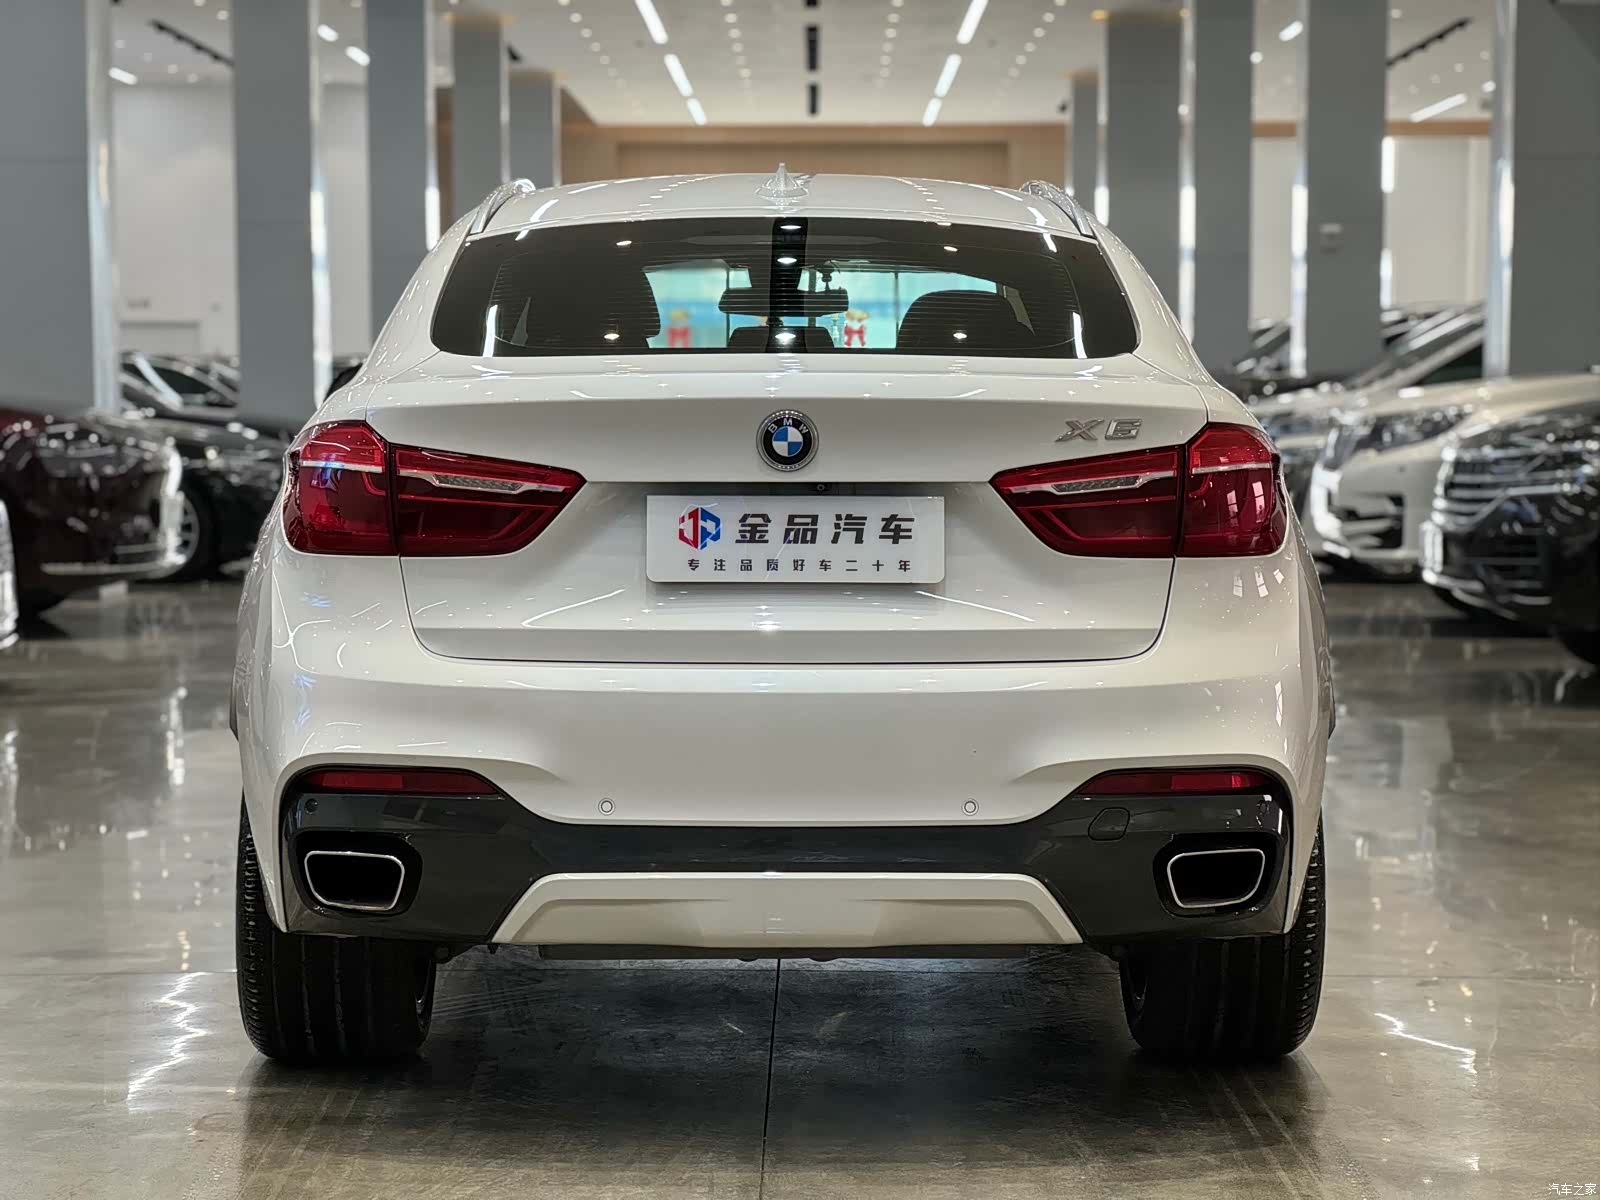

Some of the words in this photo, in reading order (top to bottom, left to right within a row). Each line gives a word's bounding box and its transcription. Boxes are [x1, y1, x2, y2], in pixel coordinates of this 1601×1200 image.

[768, 418, 809, 434] BMW
[1054, 418, 1143, 442] X6
[735, 513, 915, 545] 金品汽车
[687, 558, 911, 572] 专注品质好车二十年
